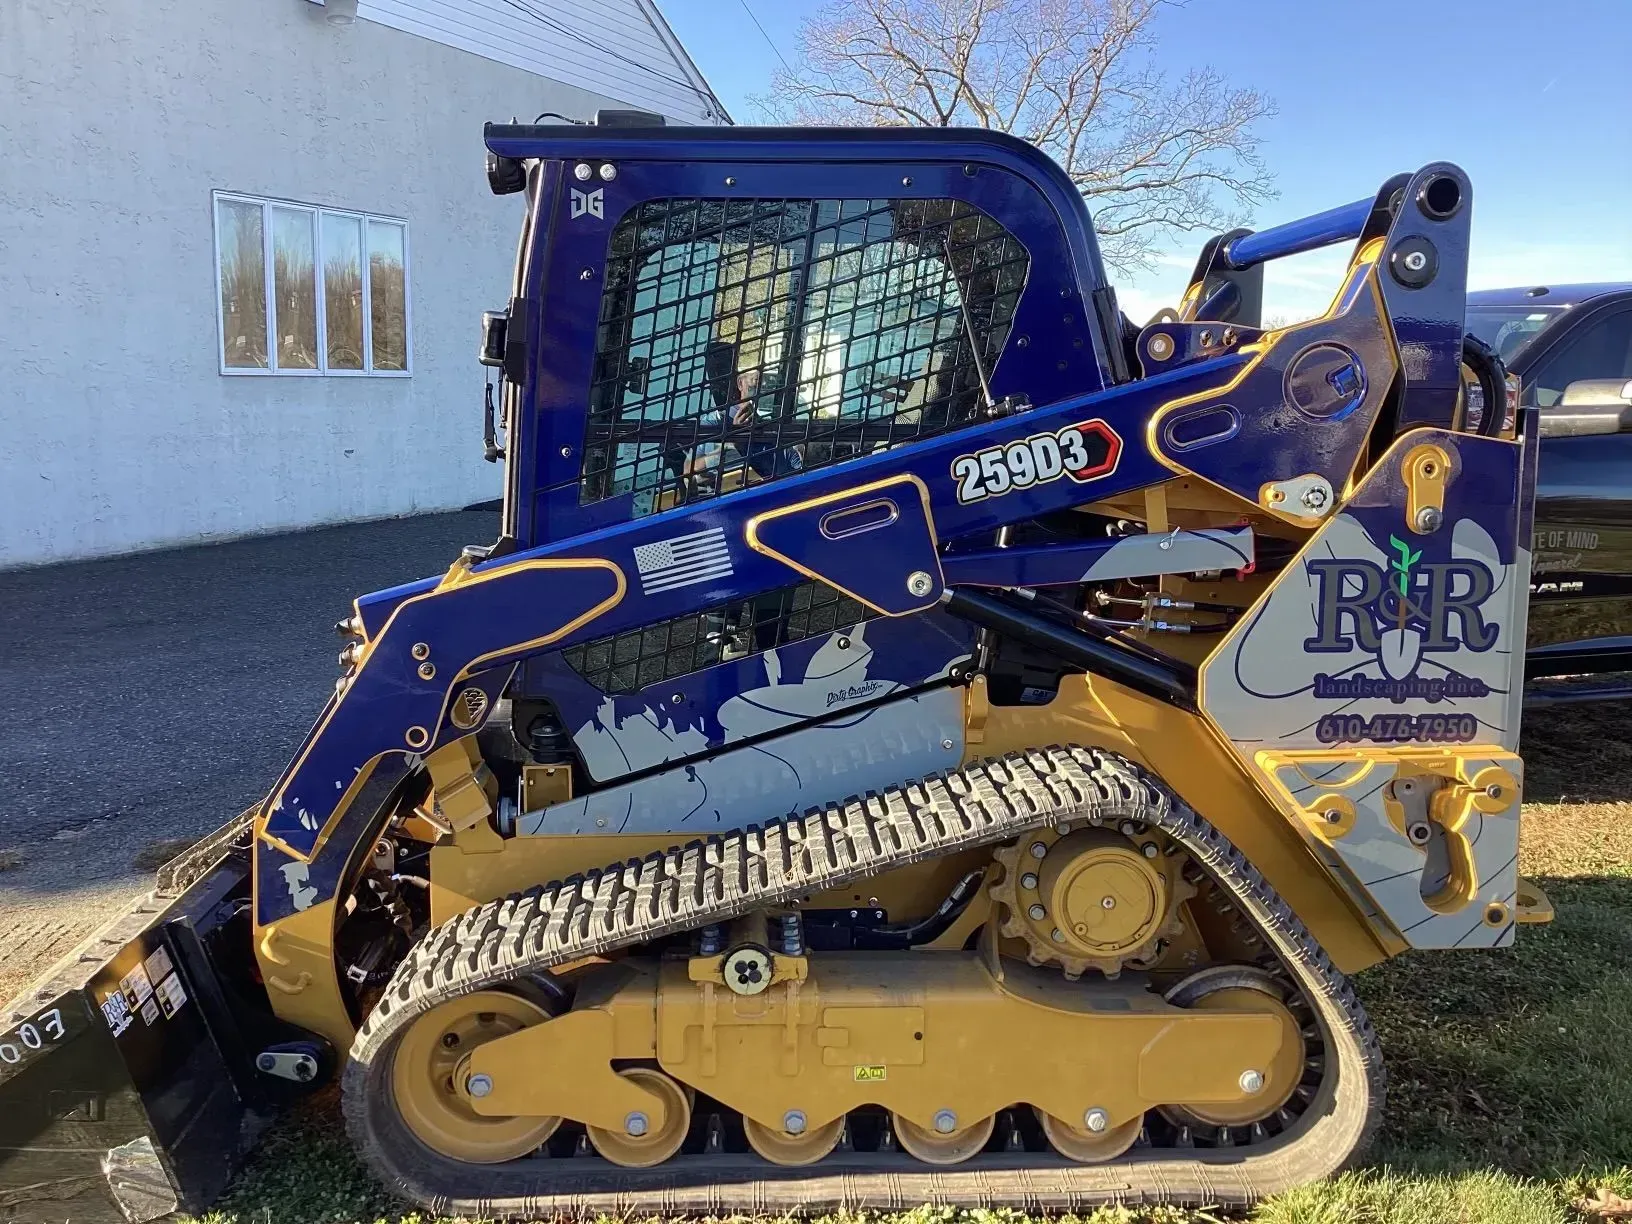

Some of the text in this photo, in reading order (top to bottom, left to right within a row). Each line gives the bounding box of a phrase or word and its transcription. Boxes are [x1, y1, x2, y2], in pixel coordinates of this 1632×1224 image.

[955, 429, 1089, 502] 259D3
[1548, 531, 1565, 548] OF
[1566, 531, 1599, 549] MIND
[1306, 562, 1498, 651] R&R
[827, 681, 878, 704] Dirty Graphix
[1319, 677, 1441, 698] landscaping
[1320, 717, 1474, 741] 610-476-7950
